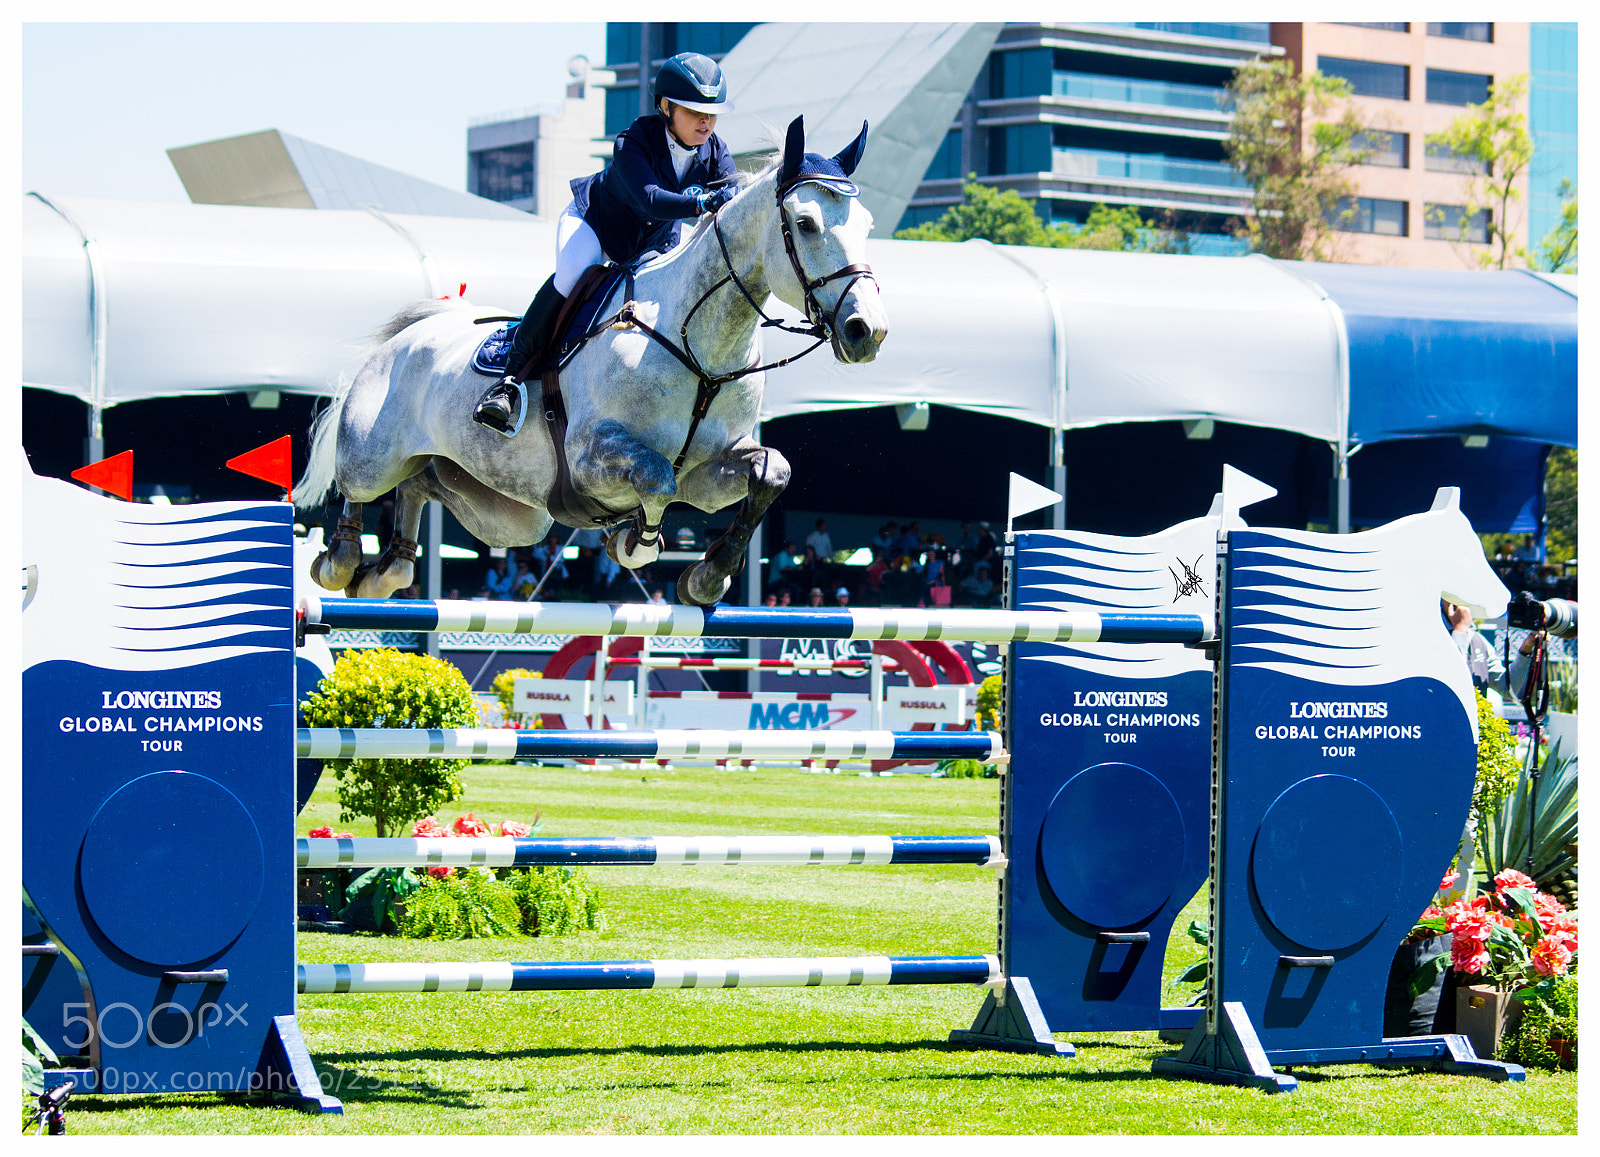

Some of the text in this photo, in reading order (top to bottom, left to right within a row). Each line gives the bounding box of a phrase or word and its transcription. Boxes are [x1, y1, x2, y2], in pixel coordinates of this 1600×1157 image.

[102, 691, 221, 709] LONGINES
[526, 692, 571, 702] RUSSULA
[1073, 692, 1168, 708] LONGINES
[900, 700, 946, 710] RUSSULA
[1290, 702, 1388, 719] LONGINES
[59, 716, 263, 733] GLOBAL CHAMPIONS
[749, 703, 830, 731] MCM
[1040, 713, 1200, 728] GLOBAL CHAMPIONS
[1104, 732, 1137, 744] TOUR
[1255, 725, 1422, 740] GLOBAL CHAMPIONS
[140, 739, 183, 753] TOUR
[1321, 746, 1356, 758] TOUR
